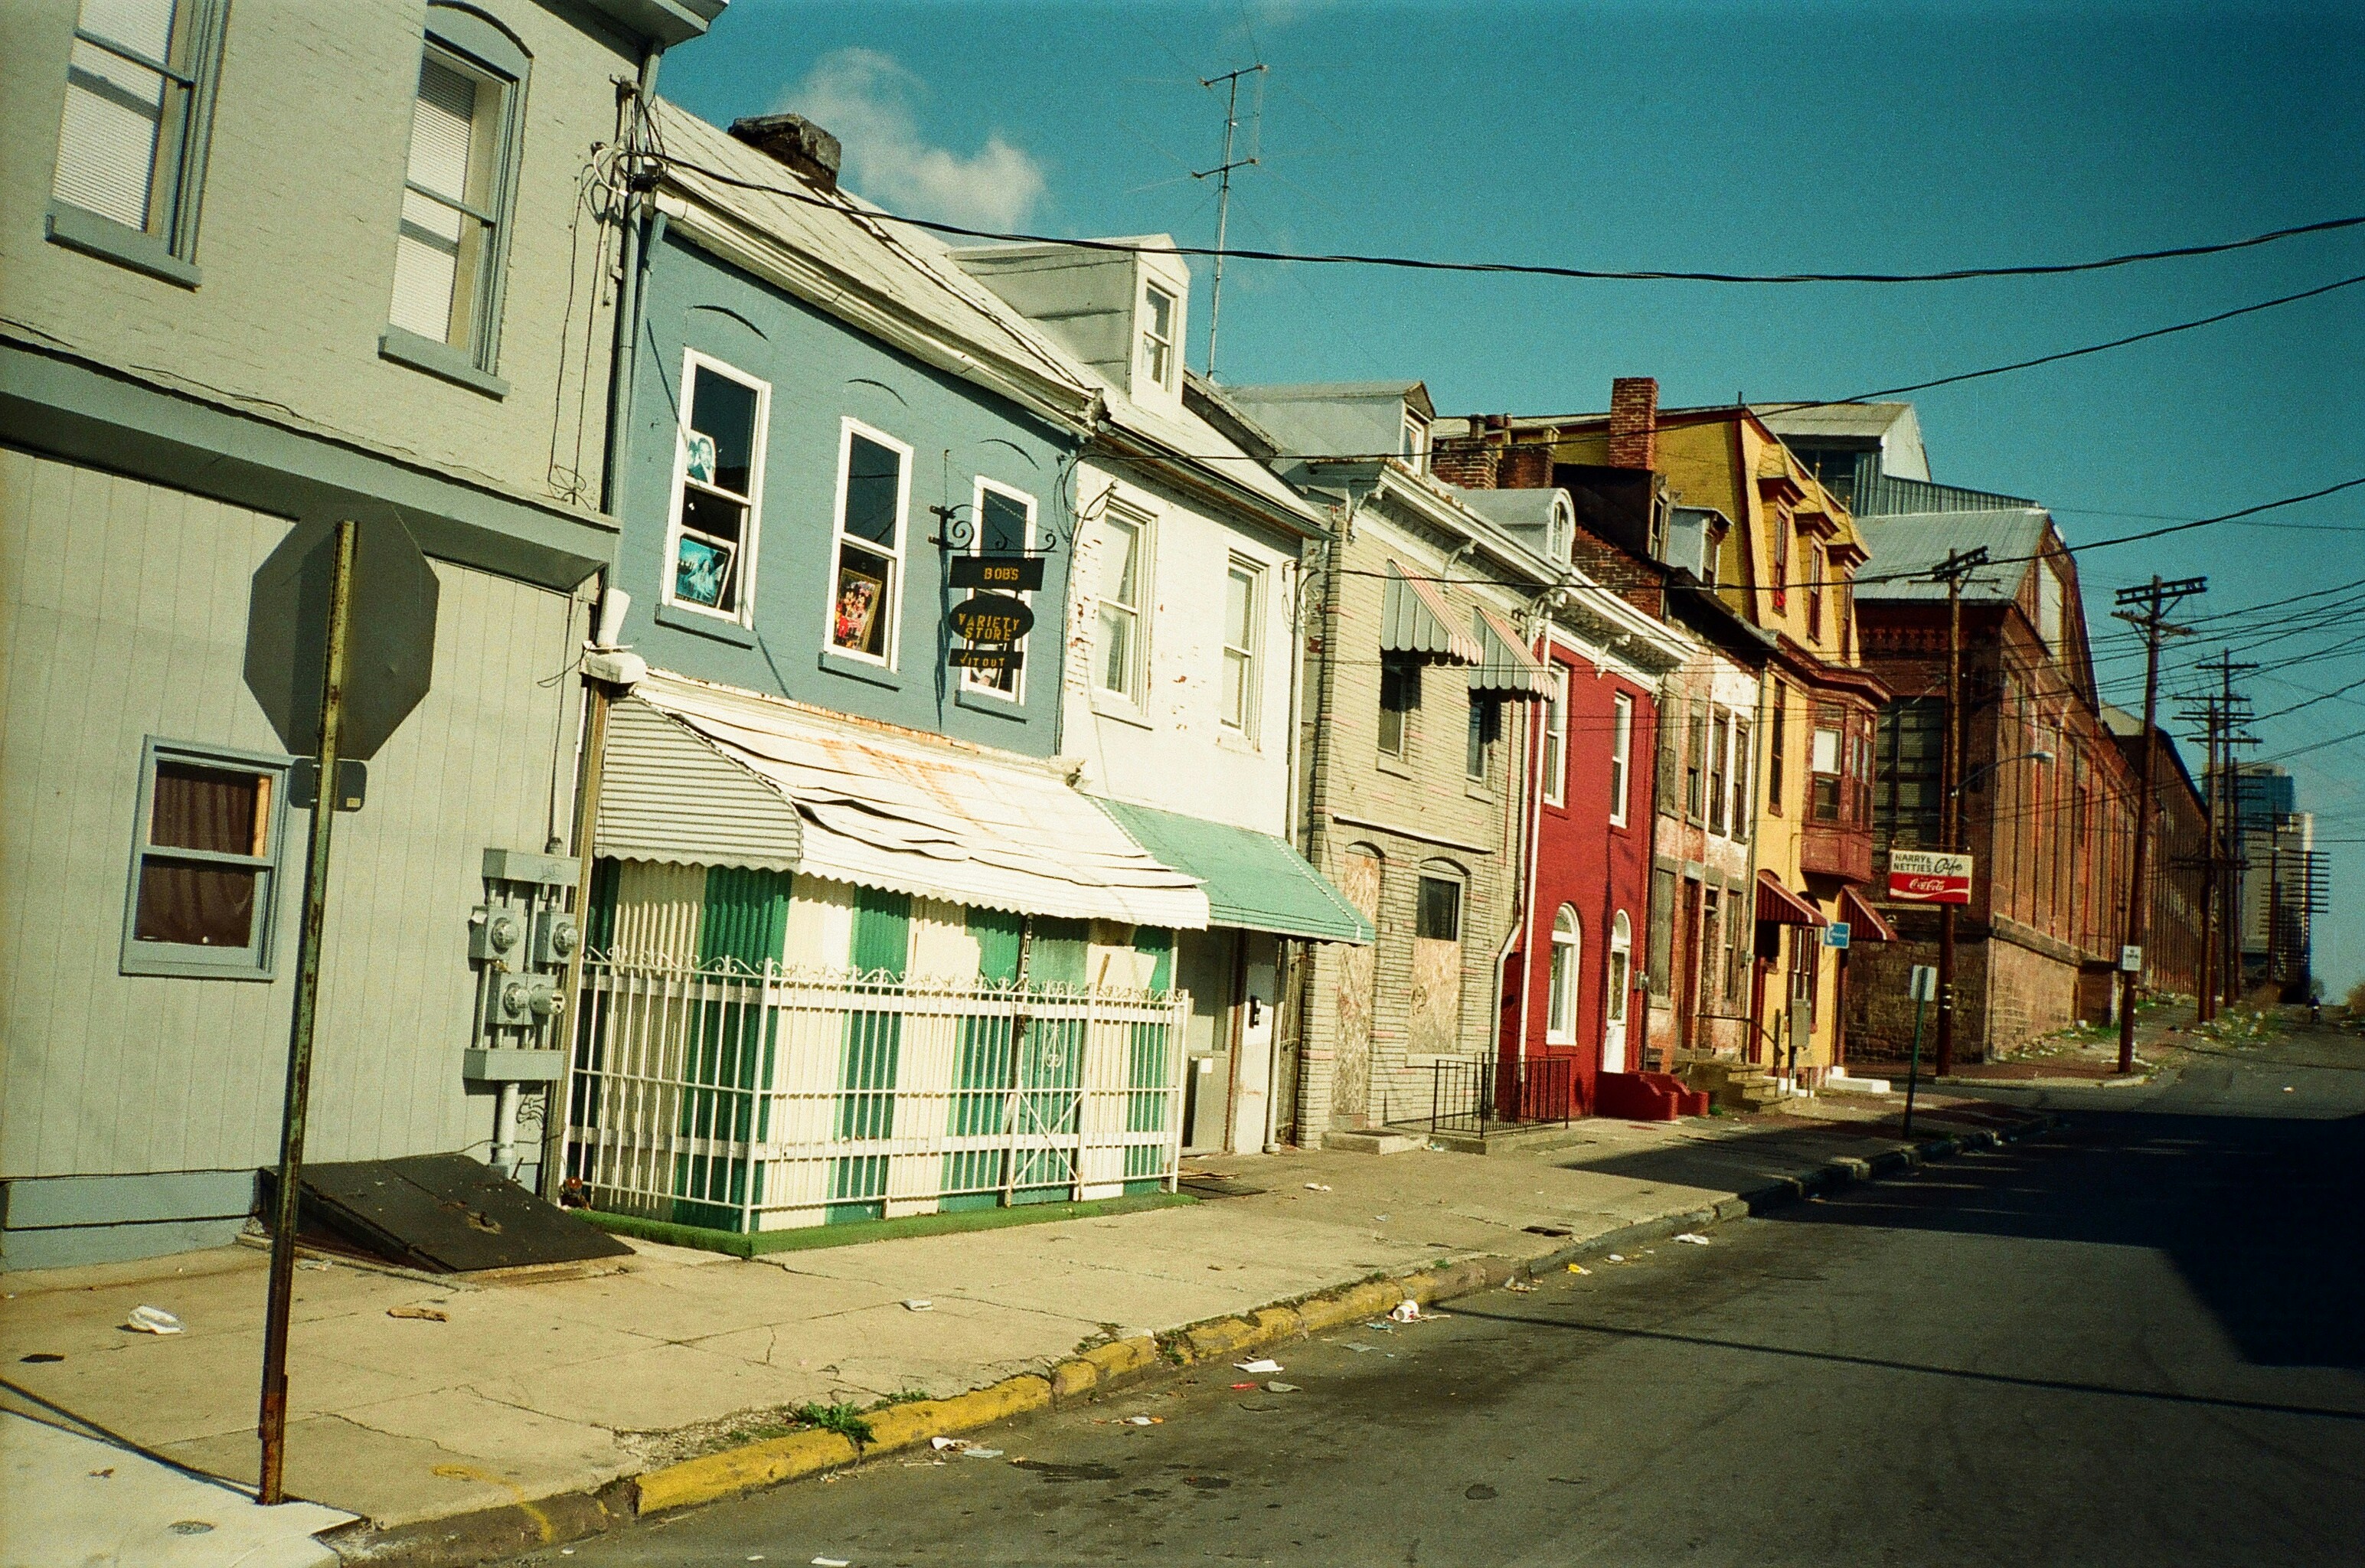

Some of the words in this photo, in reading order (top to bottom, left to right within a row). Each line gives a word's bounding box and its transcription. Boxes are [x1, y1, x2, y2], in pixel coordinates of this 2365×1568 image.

[959, 613, 1020, 631] VARIETY
[965, 627, 1011, 641] STORE
[982, 658, 1004, 667] OUT
